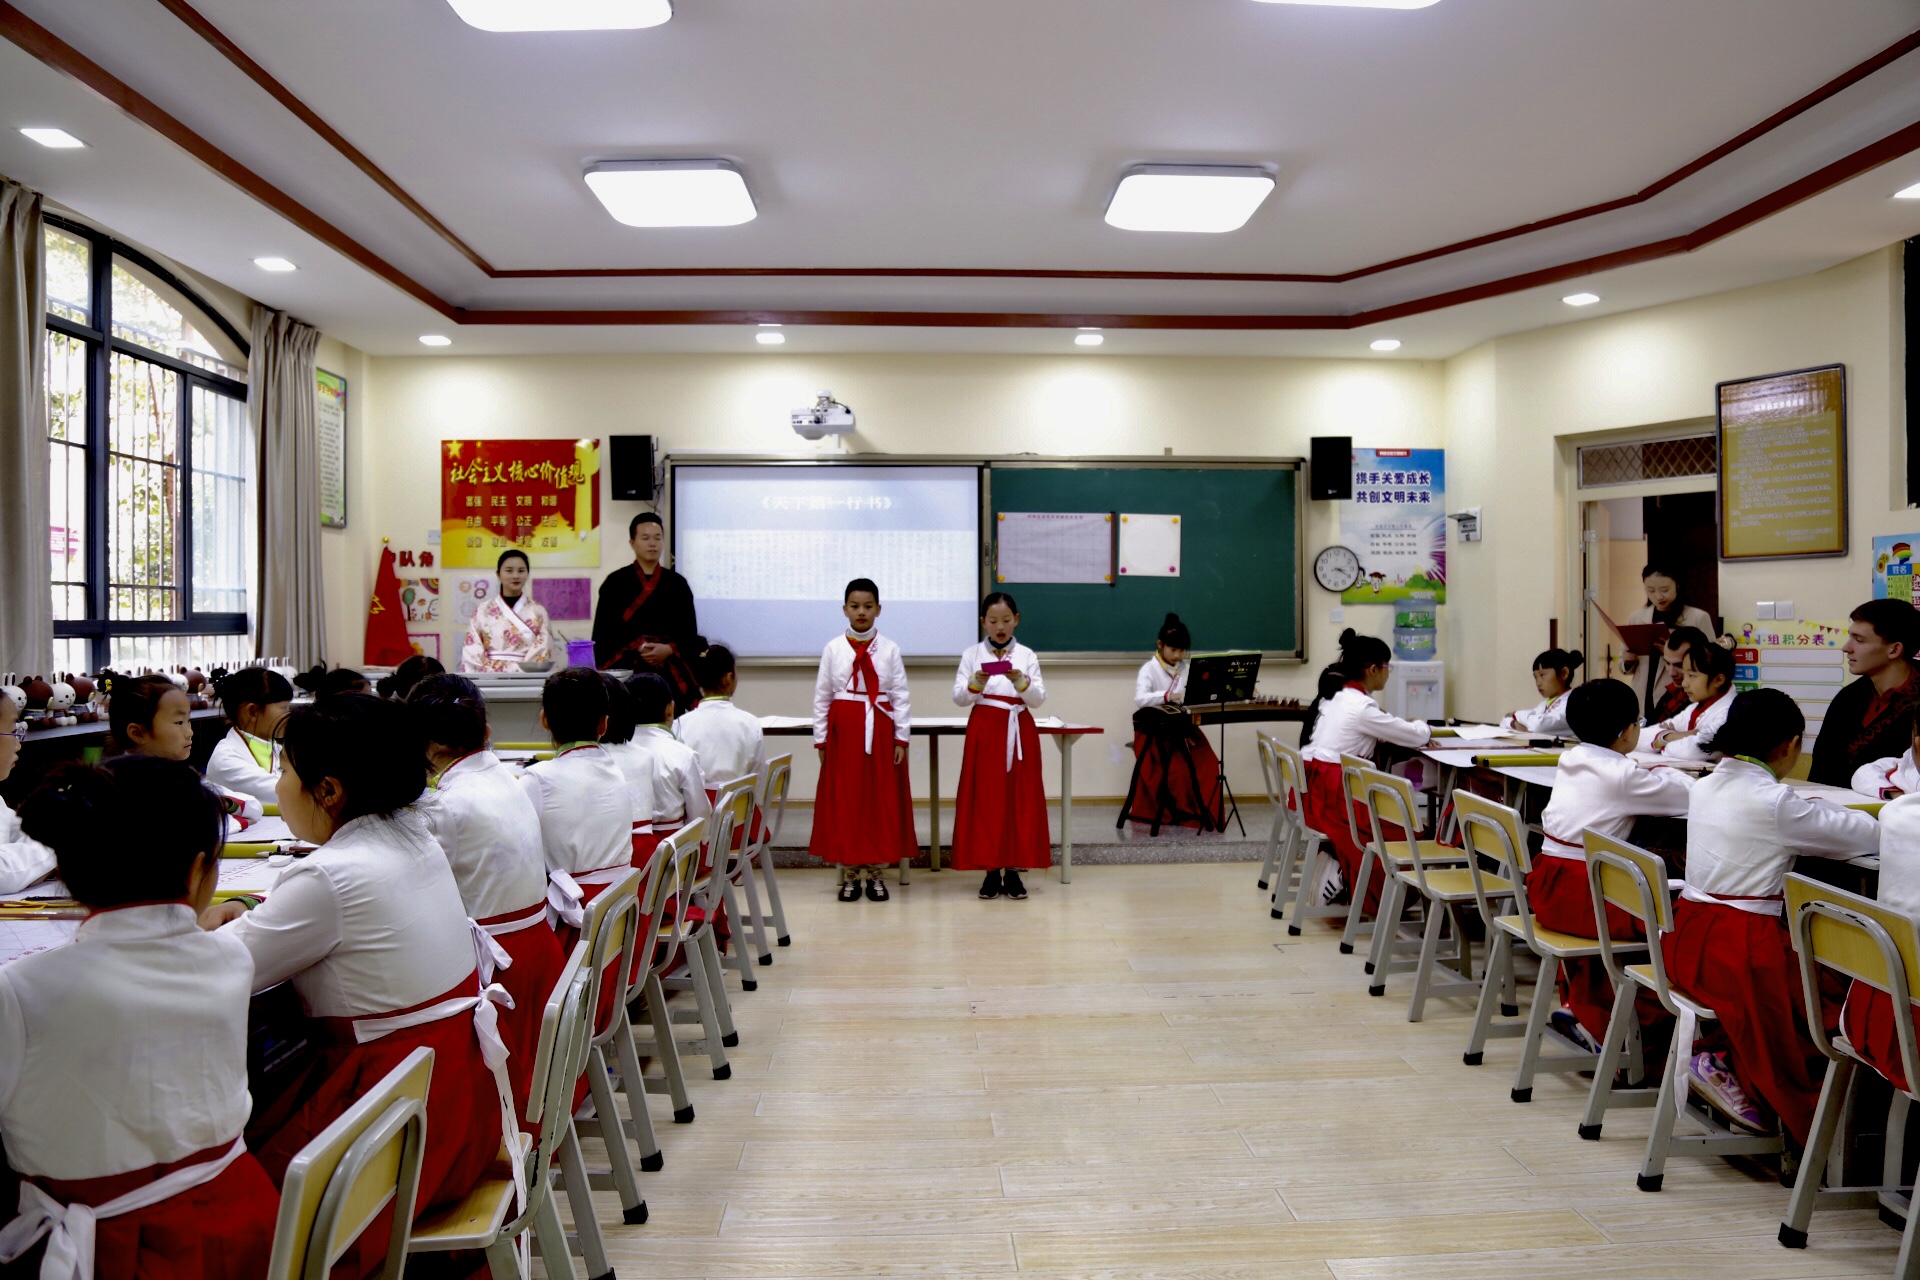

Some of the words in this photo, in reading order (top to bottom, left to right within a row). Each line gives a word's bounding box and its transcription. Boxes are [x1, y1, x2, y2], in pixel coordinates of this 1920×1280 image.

[450, 459, 585, 489] 社会主义核心价值观
[1356, 472, 1430, 485] 携手关爱成长
[491, 496, 507, 507] 民主
[516, 496, 532, 507] 文明
[1356, 491, 1430, 503] 共创文明未来
[466, 516, 482, 527] 自由
[491, 516, 507, 527] 平等
[516, 516, 532, 527] 公正
[1892, 565, 1907, 574] 姓名
[1755, 634, 1825, 646] 小组积分表
[1735, 651, 1754, 661] 一组
[1735, 668, 1754, 679] 二组
